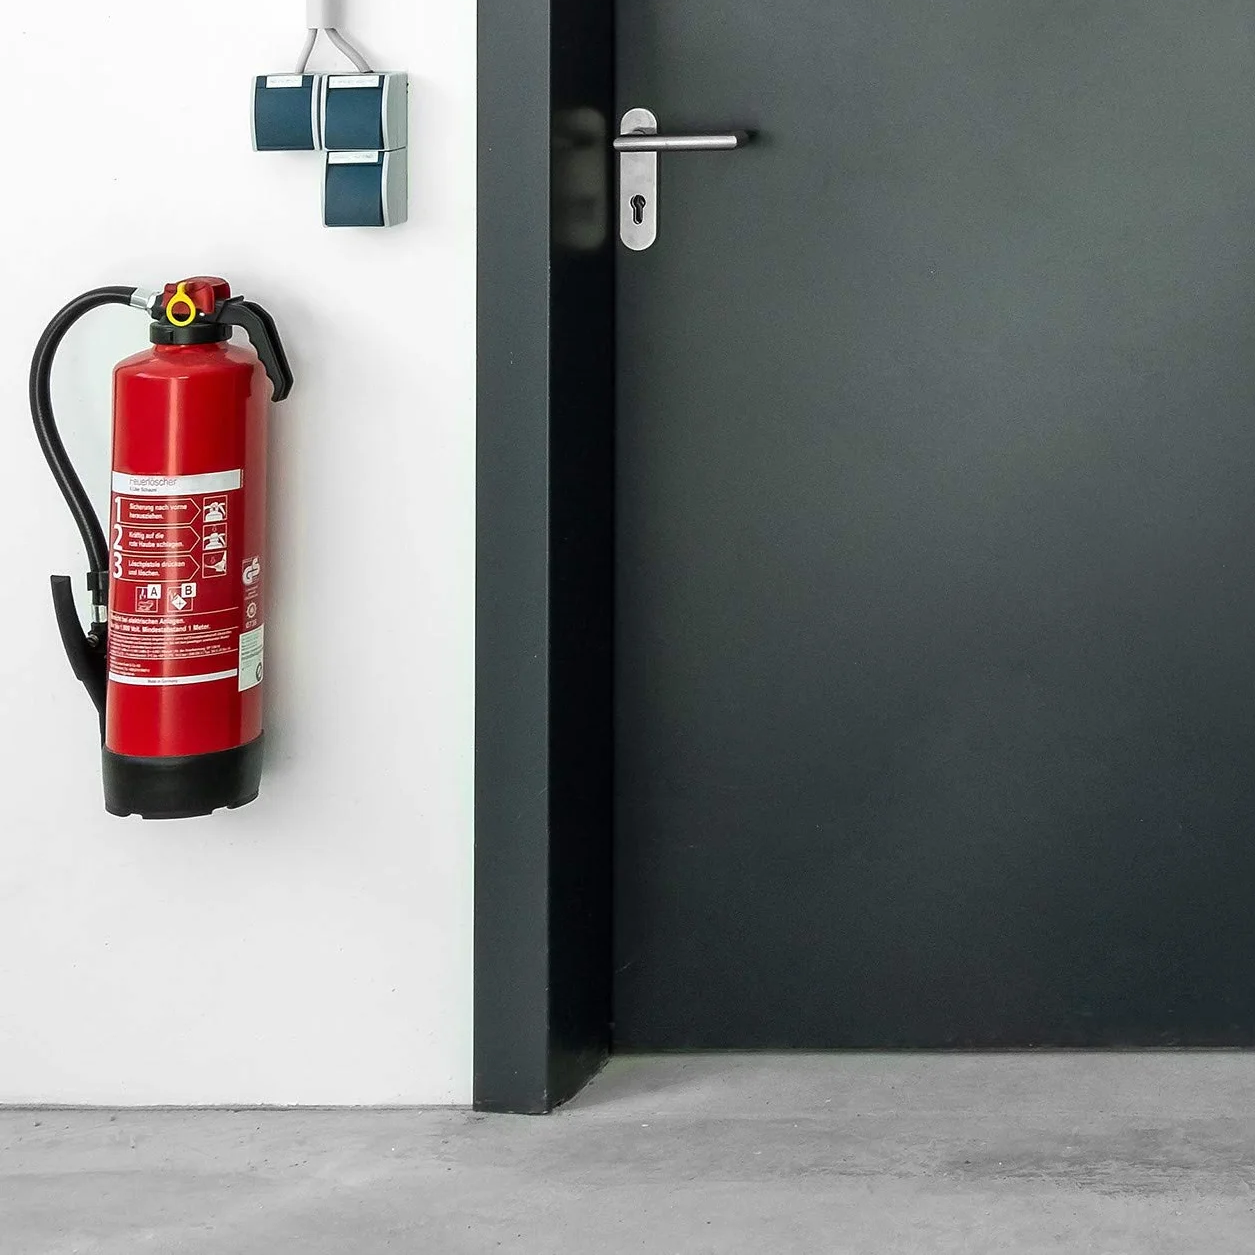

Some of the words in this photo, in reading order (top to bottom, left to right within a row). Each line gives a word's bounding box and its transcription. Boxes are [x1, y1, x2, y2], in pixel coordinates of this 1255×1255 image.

[114, 496, 121, 523] 1
[129, 503, 154, 512] Sicherung
[113, 524, 123, 550] 2
[113, 551, 123, 578] 3
[150, 587, 158, 596] A
[185, 585, 192, 595] B
[128, 617, 159, 625] elektrischen
